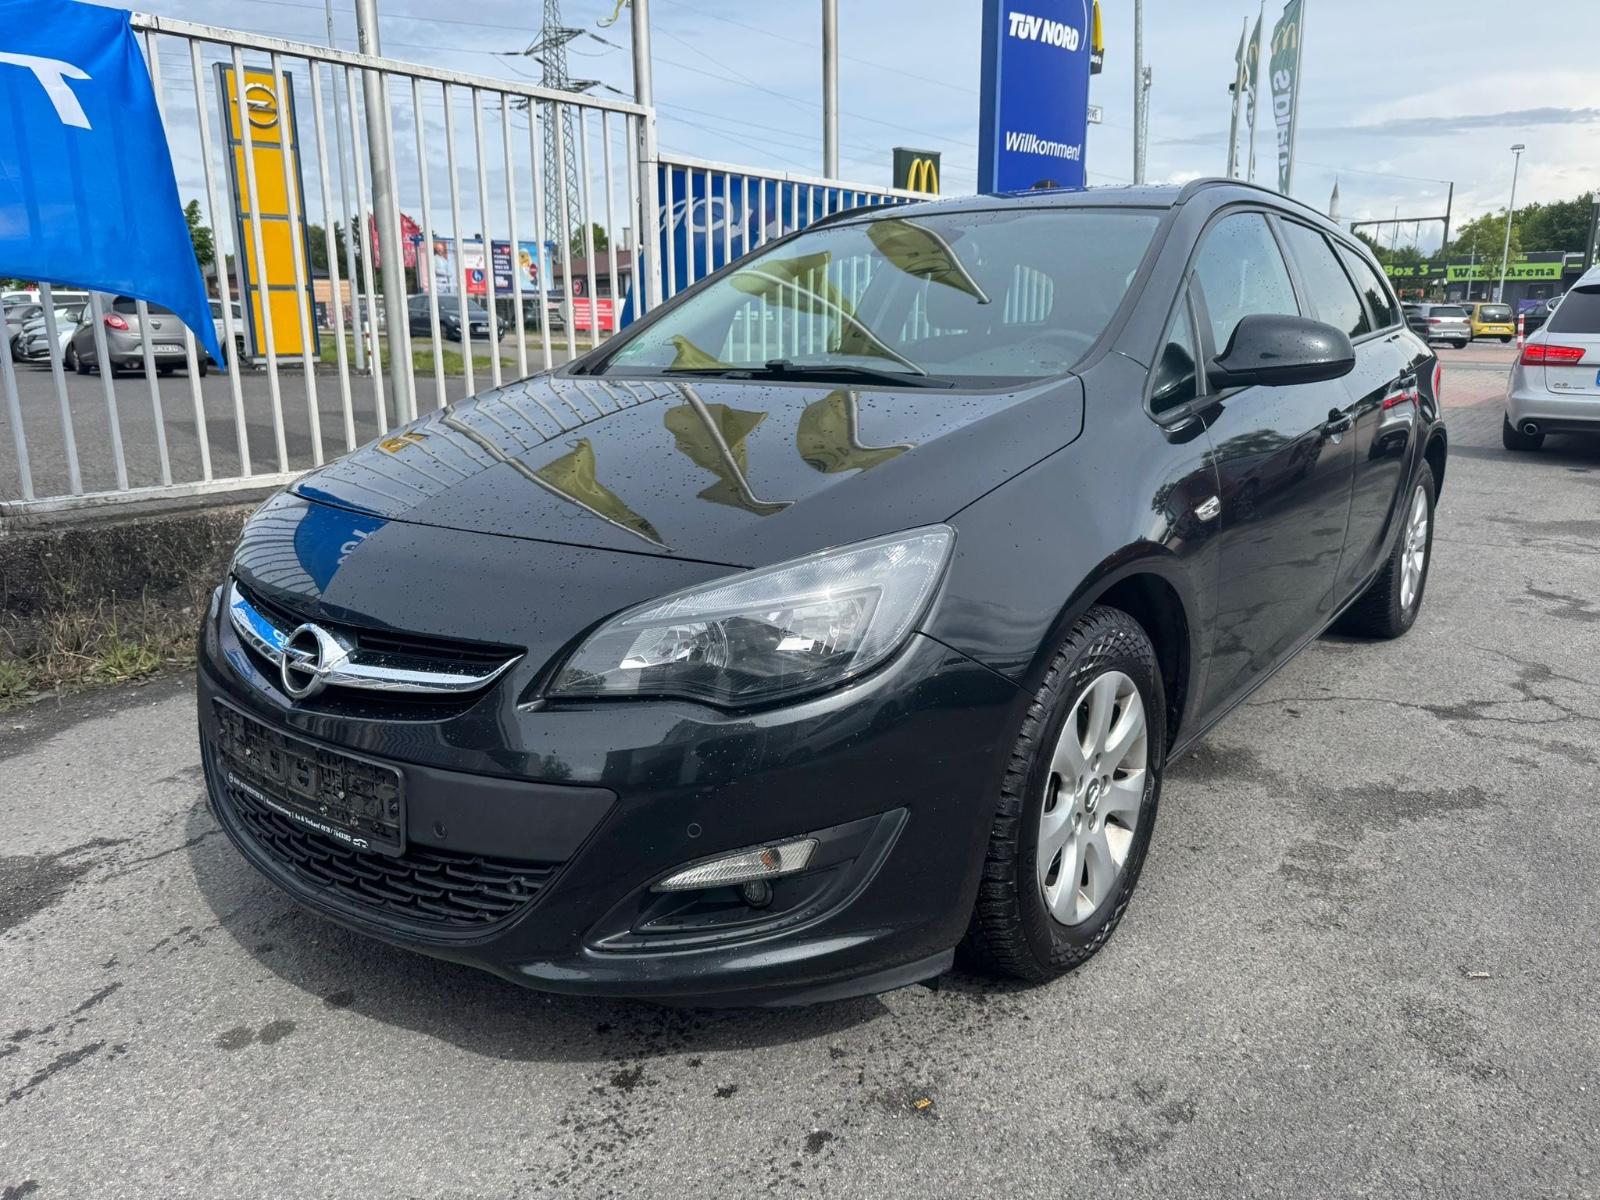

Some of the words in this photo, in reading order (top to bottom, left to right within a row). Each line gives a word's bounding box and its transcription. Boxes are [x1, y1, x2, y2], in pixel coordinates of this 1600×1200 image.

[1009, 11, 1043, 41] TÜV
[1040, 19, 1080, 52] NORD
[1005, 130, 1082, 161] Willkommen!
[1383, 264, 1414, 277] Box
[1418, 264, 1429, 276] 3
[1453, 266, 1555, 279] WashArena
